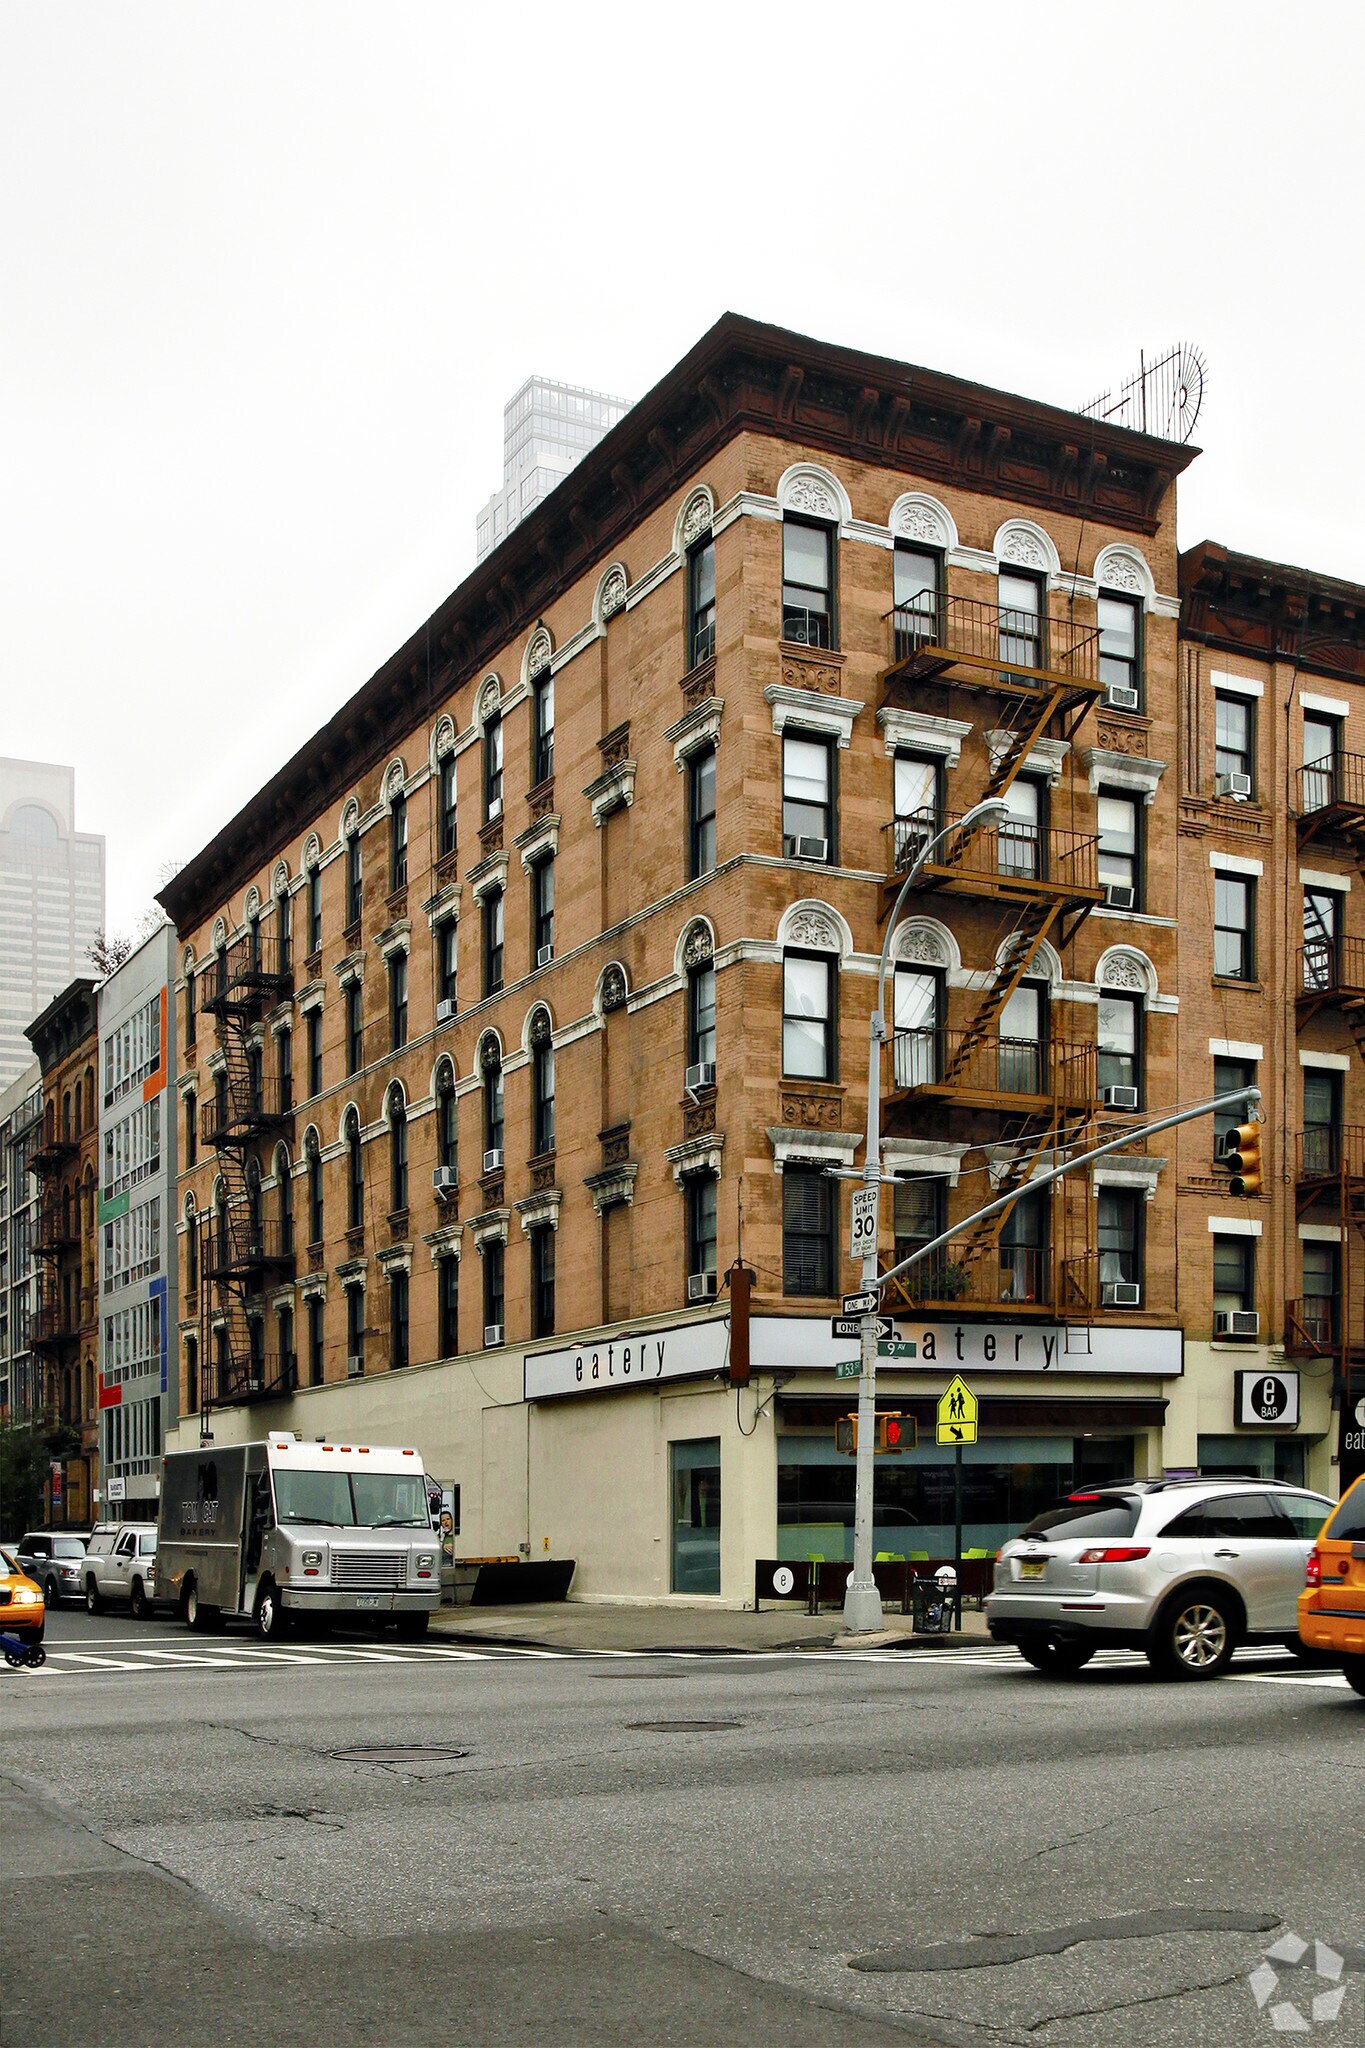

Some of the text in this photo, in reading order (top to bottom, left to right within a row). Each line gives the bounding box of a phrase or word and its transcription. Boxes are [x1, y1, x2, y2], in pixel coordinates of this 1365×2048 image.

[854, 1192, 876, 1205] SPEED
[856, 1204, 873, 1216] LIMIT
[854, 1215, 874, 1239] 30
[847, 1297, 874, 1311] ONE WAY
[840, 1323, 859, 1333] ONE
[887, 1342, 896, 1356] 9
[892, 1326, 1056, 1370] atery
[575, 1340, 666, 1383] eatery
[837, 1364, 844, 1376] W
[845, 1362, 854, 1376] 53
[1263, 1378, 1275, 1406] e
[1260, 1406, 1278, 1418] BAR
[182, 1500, 219, 1524] TOM CAT
[180, 1528, 216, 1537] BAKERY
